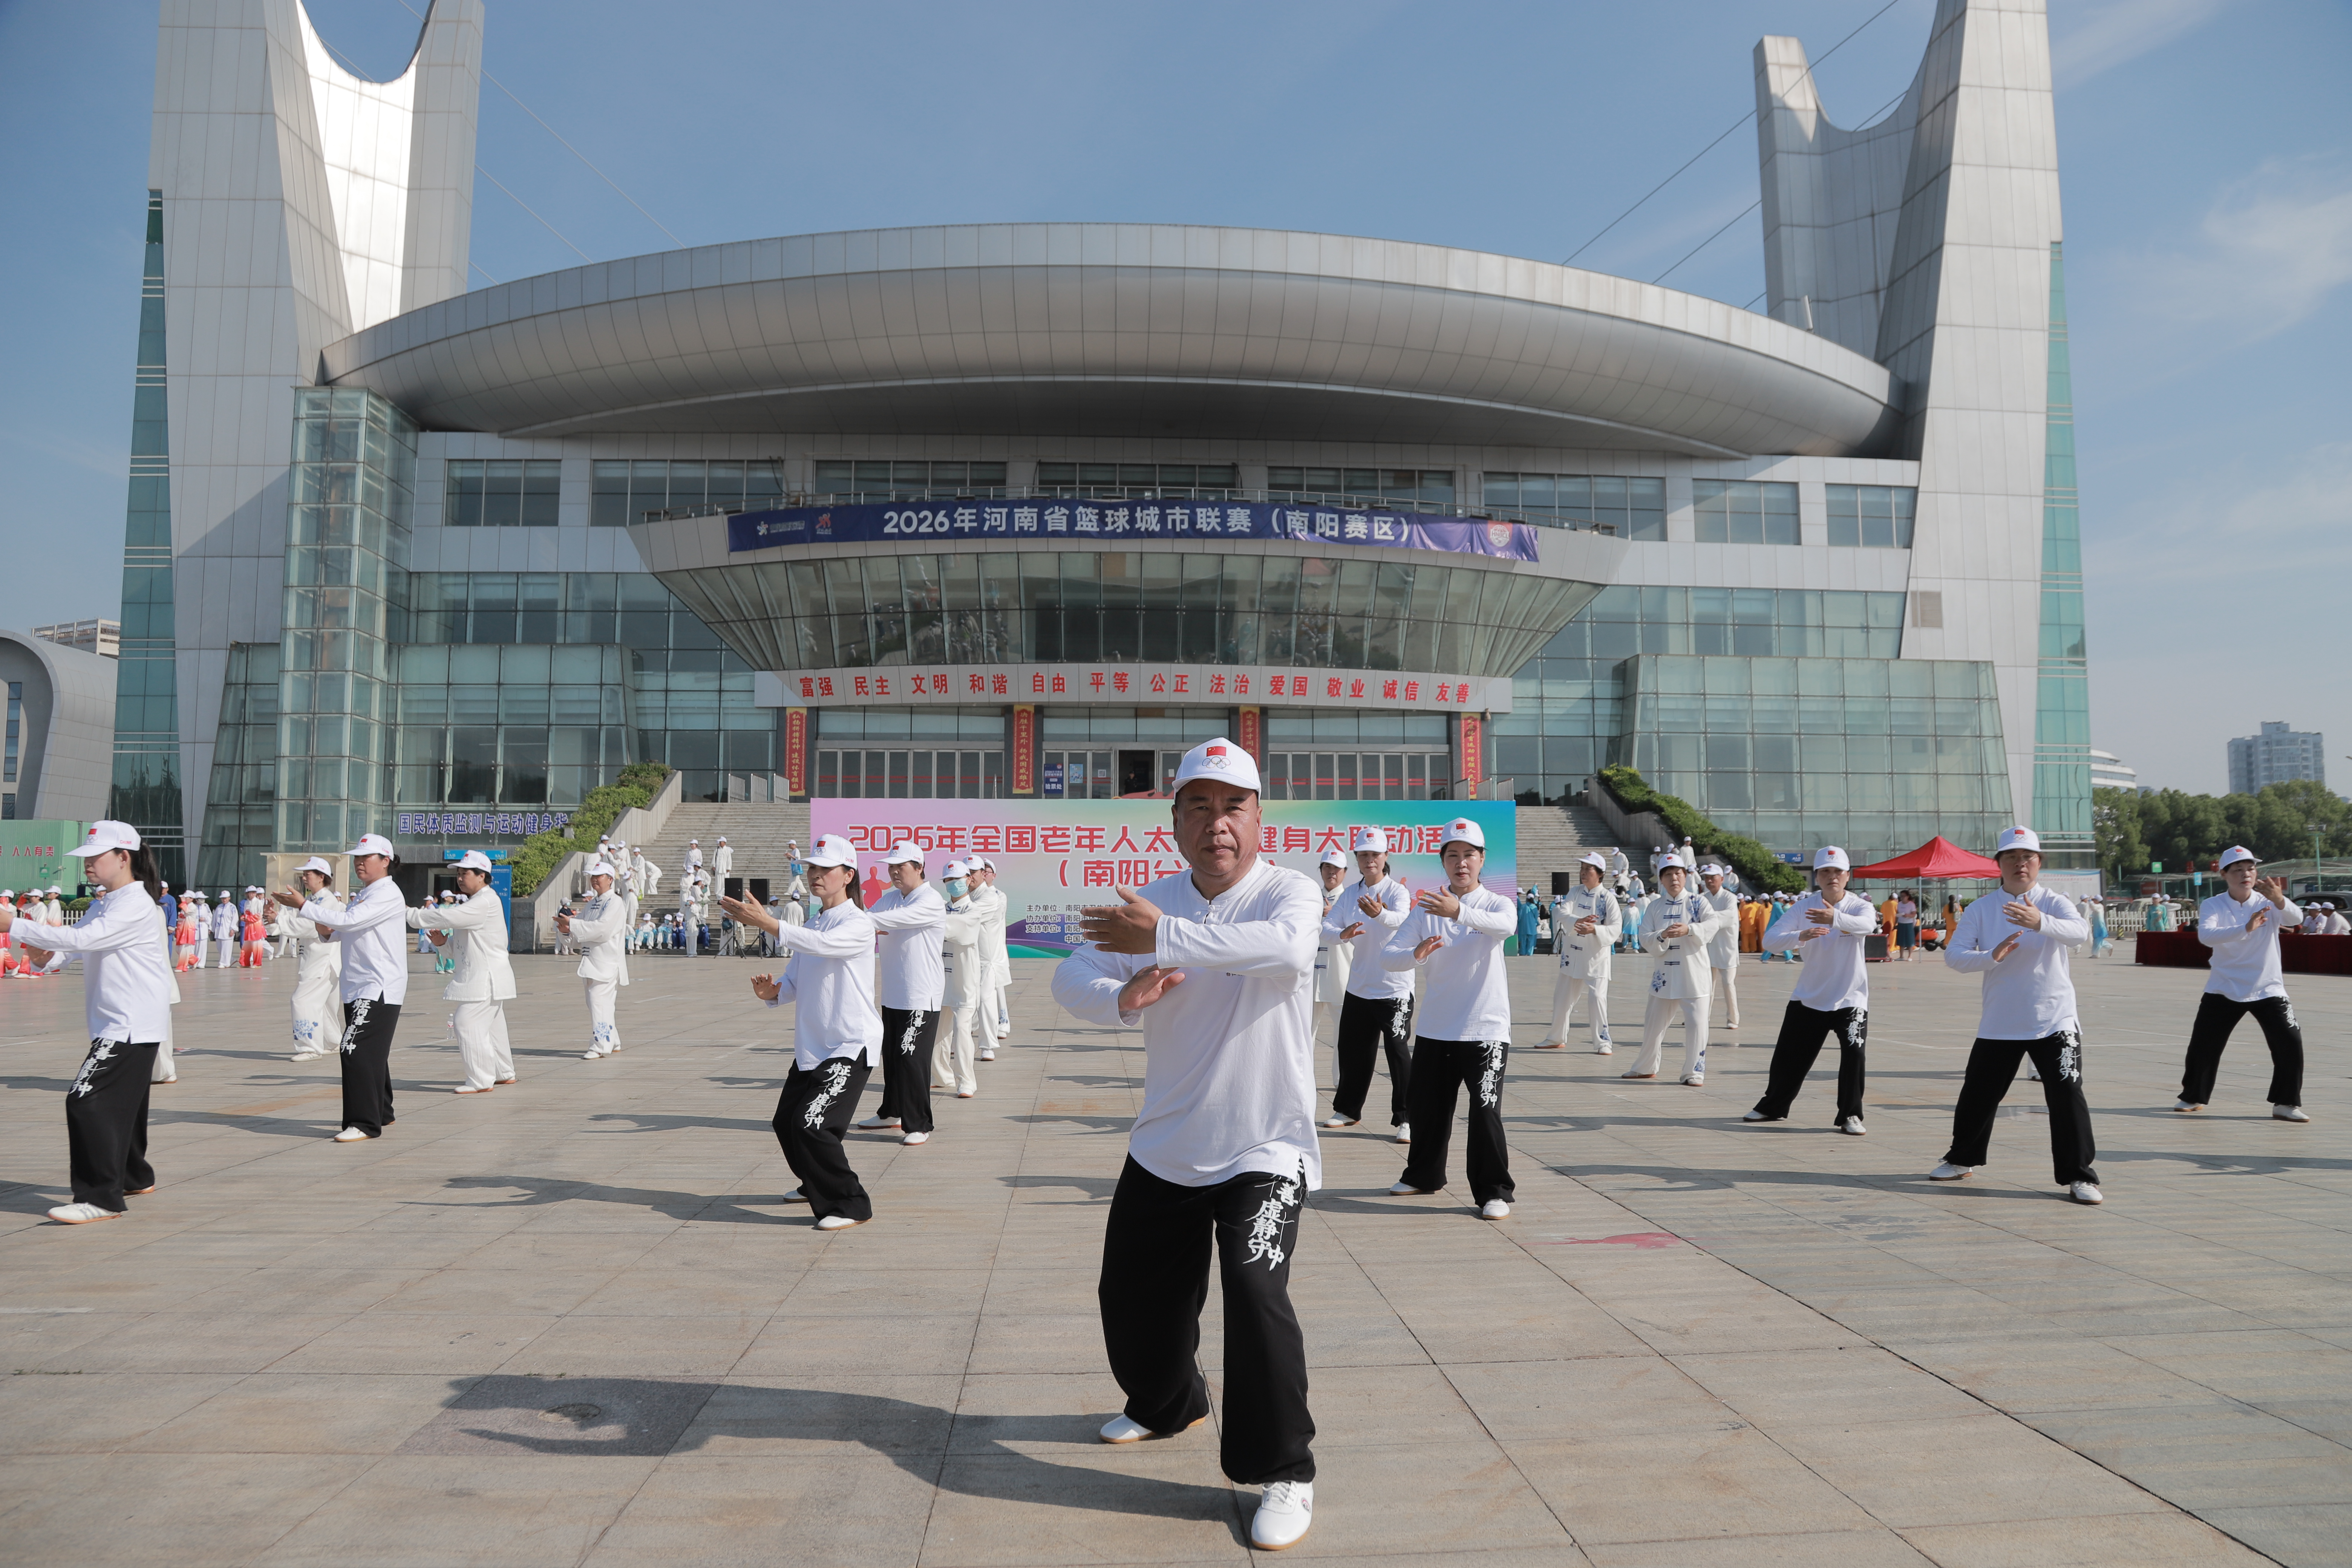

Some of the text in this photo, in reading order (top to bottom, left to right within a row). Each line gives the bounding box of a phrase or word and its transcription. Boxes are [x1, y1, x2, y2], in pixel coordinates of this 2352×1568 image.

[800, 672, 1469, 703] 富强 民主 文明 和谐 自由 平等 公正 法治 爱国 敬业 诚信 友善
[1019, 712, 1028, 745] 决胜千里外
[12, 846, 54, 856] 人人有责
[823, 1062, 851, 1096] 持正向善
